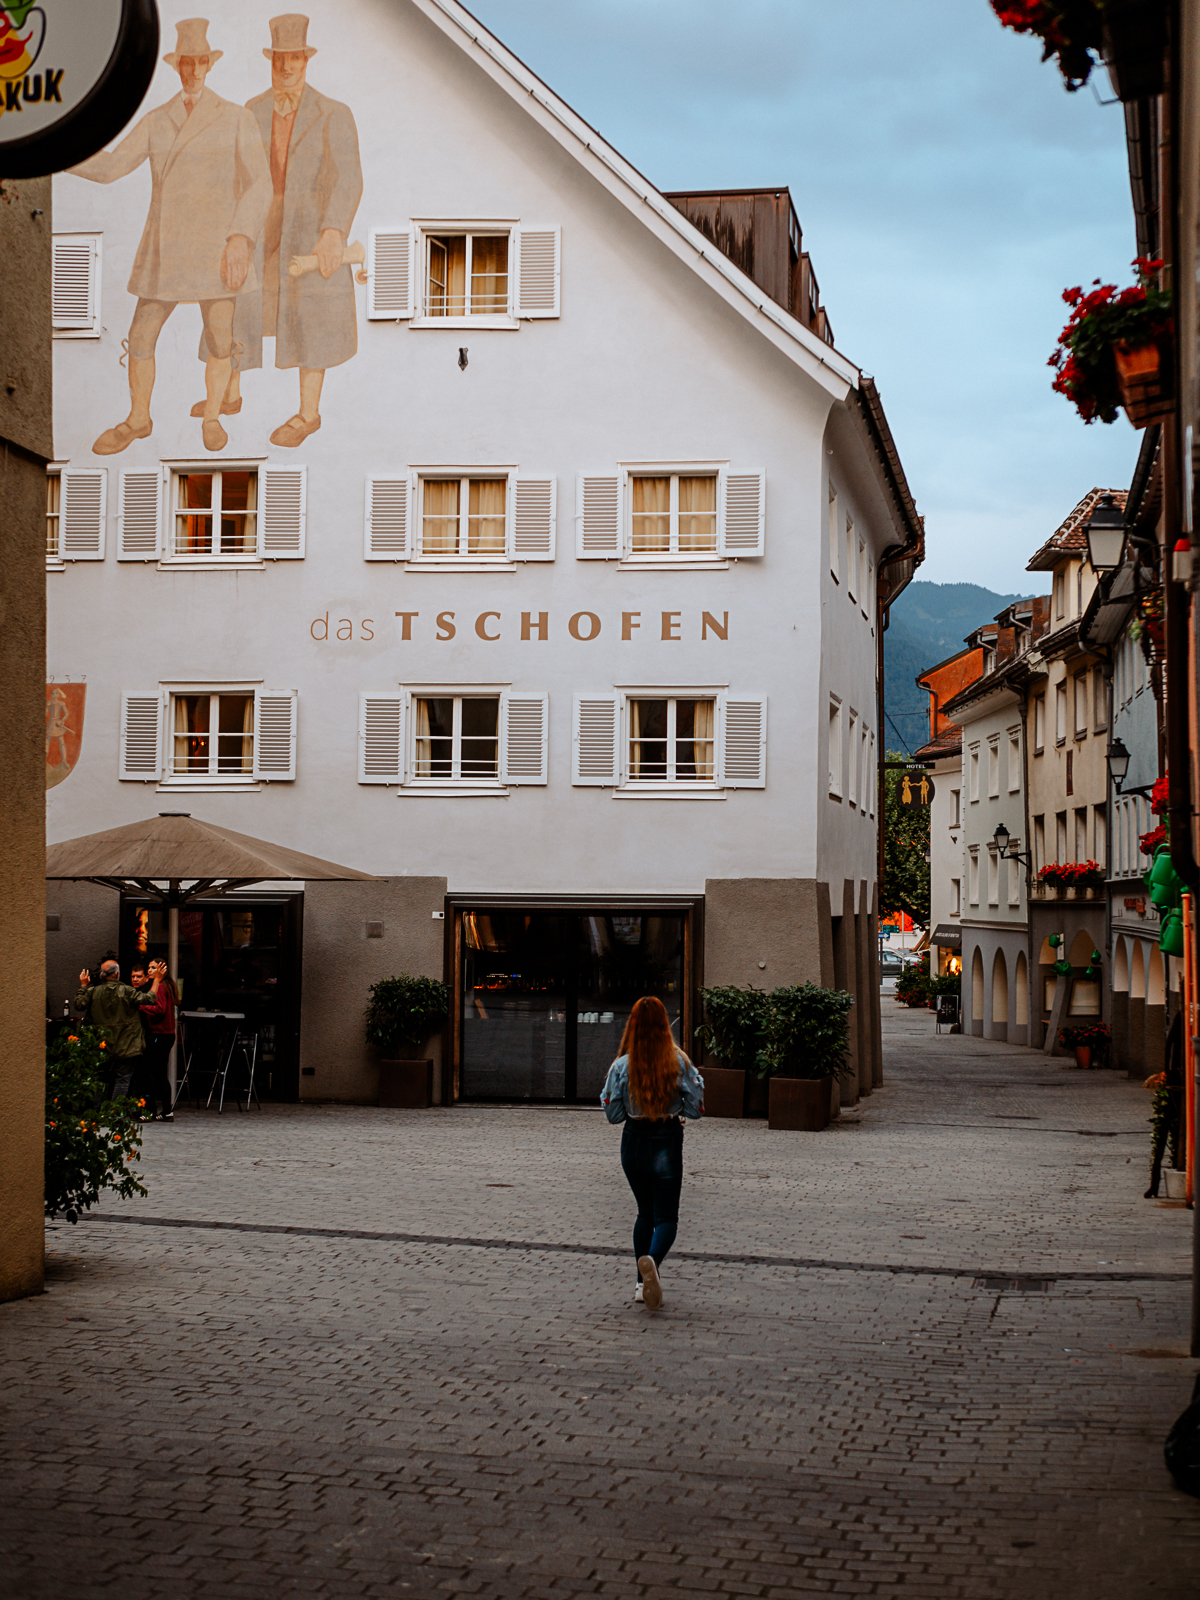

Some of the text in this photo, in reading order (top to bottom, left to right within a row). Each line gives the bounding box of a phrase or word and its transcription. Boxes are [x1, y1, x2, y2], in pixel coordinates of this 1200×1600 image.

[0, 68, 64, 111] KUK
[310, 611, 729, 641] das TSCHOFEN
